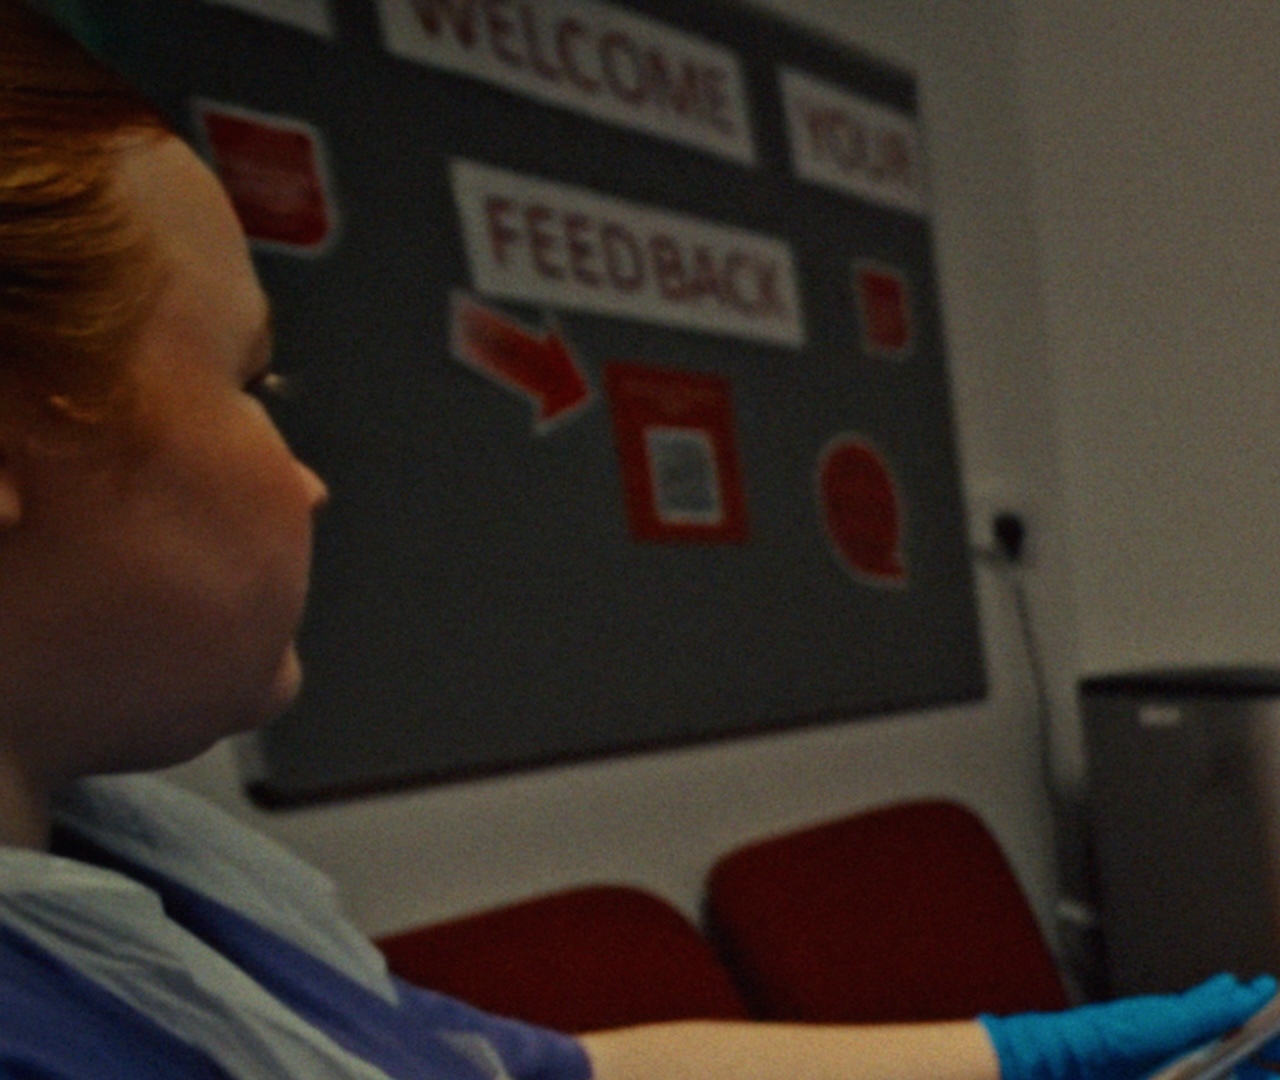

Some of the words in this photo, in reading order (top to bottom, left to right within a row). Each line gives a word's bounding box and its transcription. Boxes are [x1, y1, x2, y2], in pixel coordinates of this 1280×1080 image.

[415, 0, 732, 133] WELCOME
[798, 101, 914, 190] YOUR
[484, 194, 787, 316] FEEDBACK
